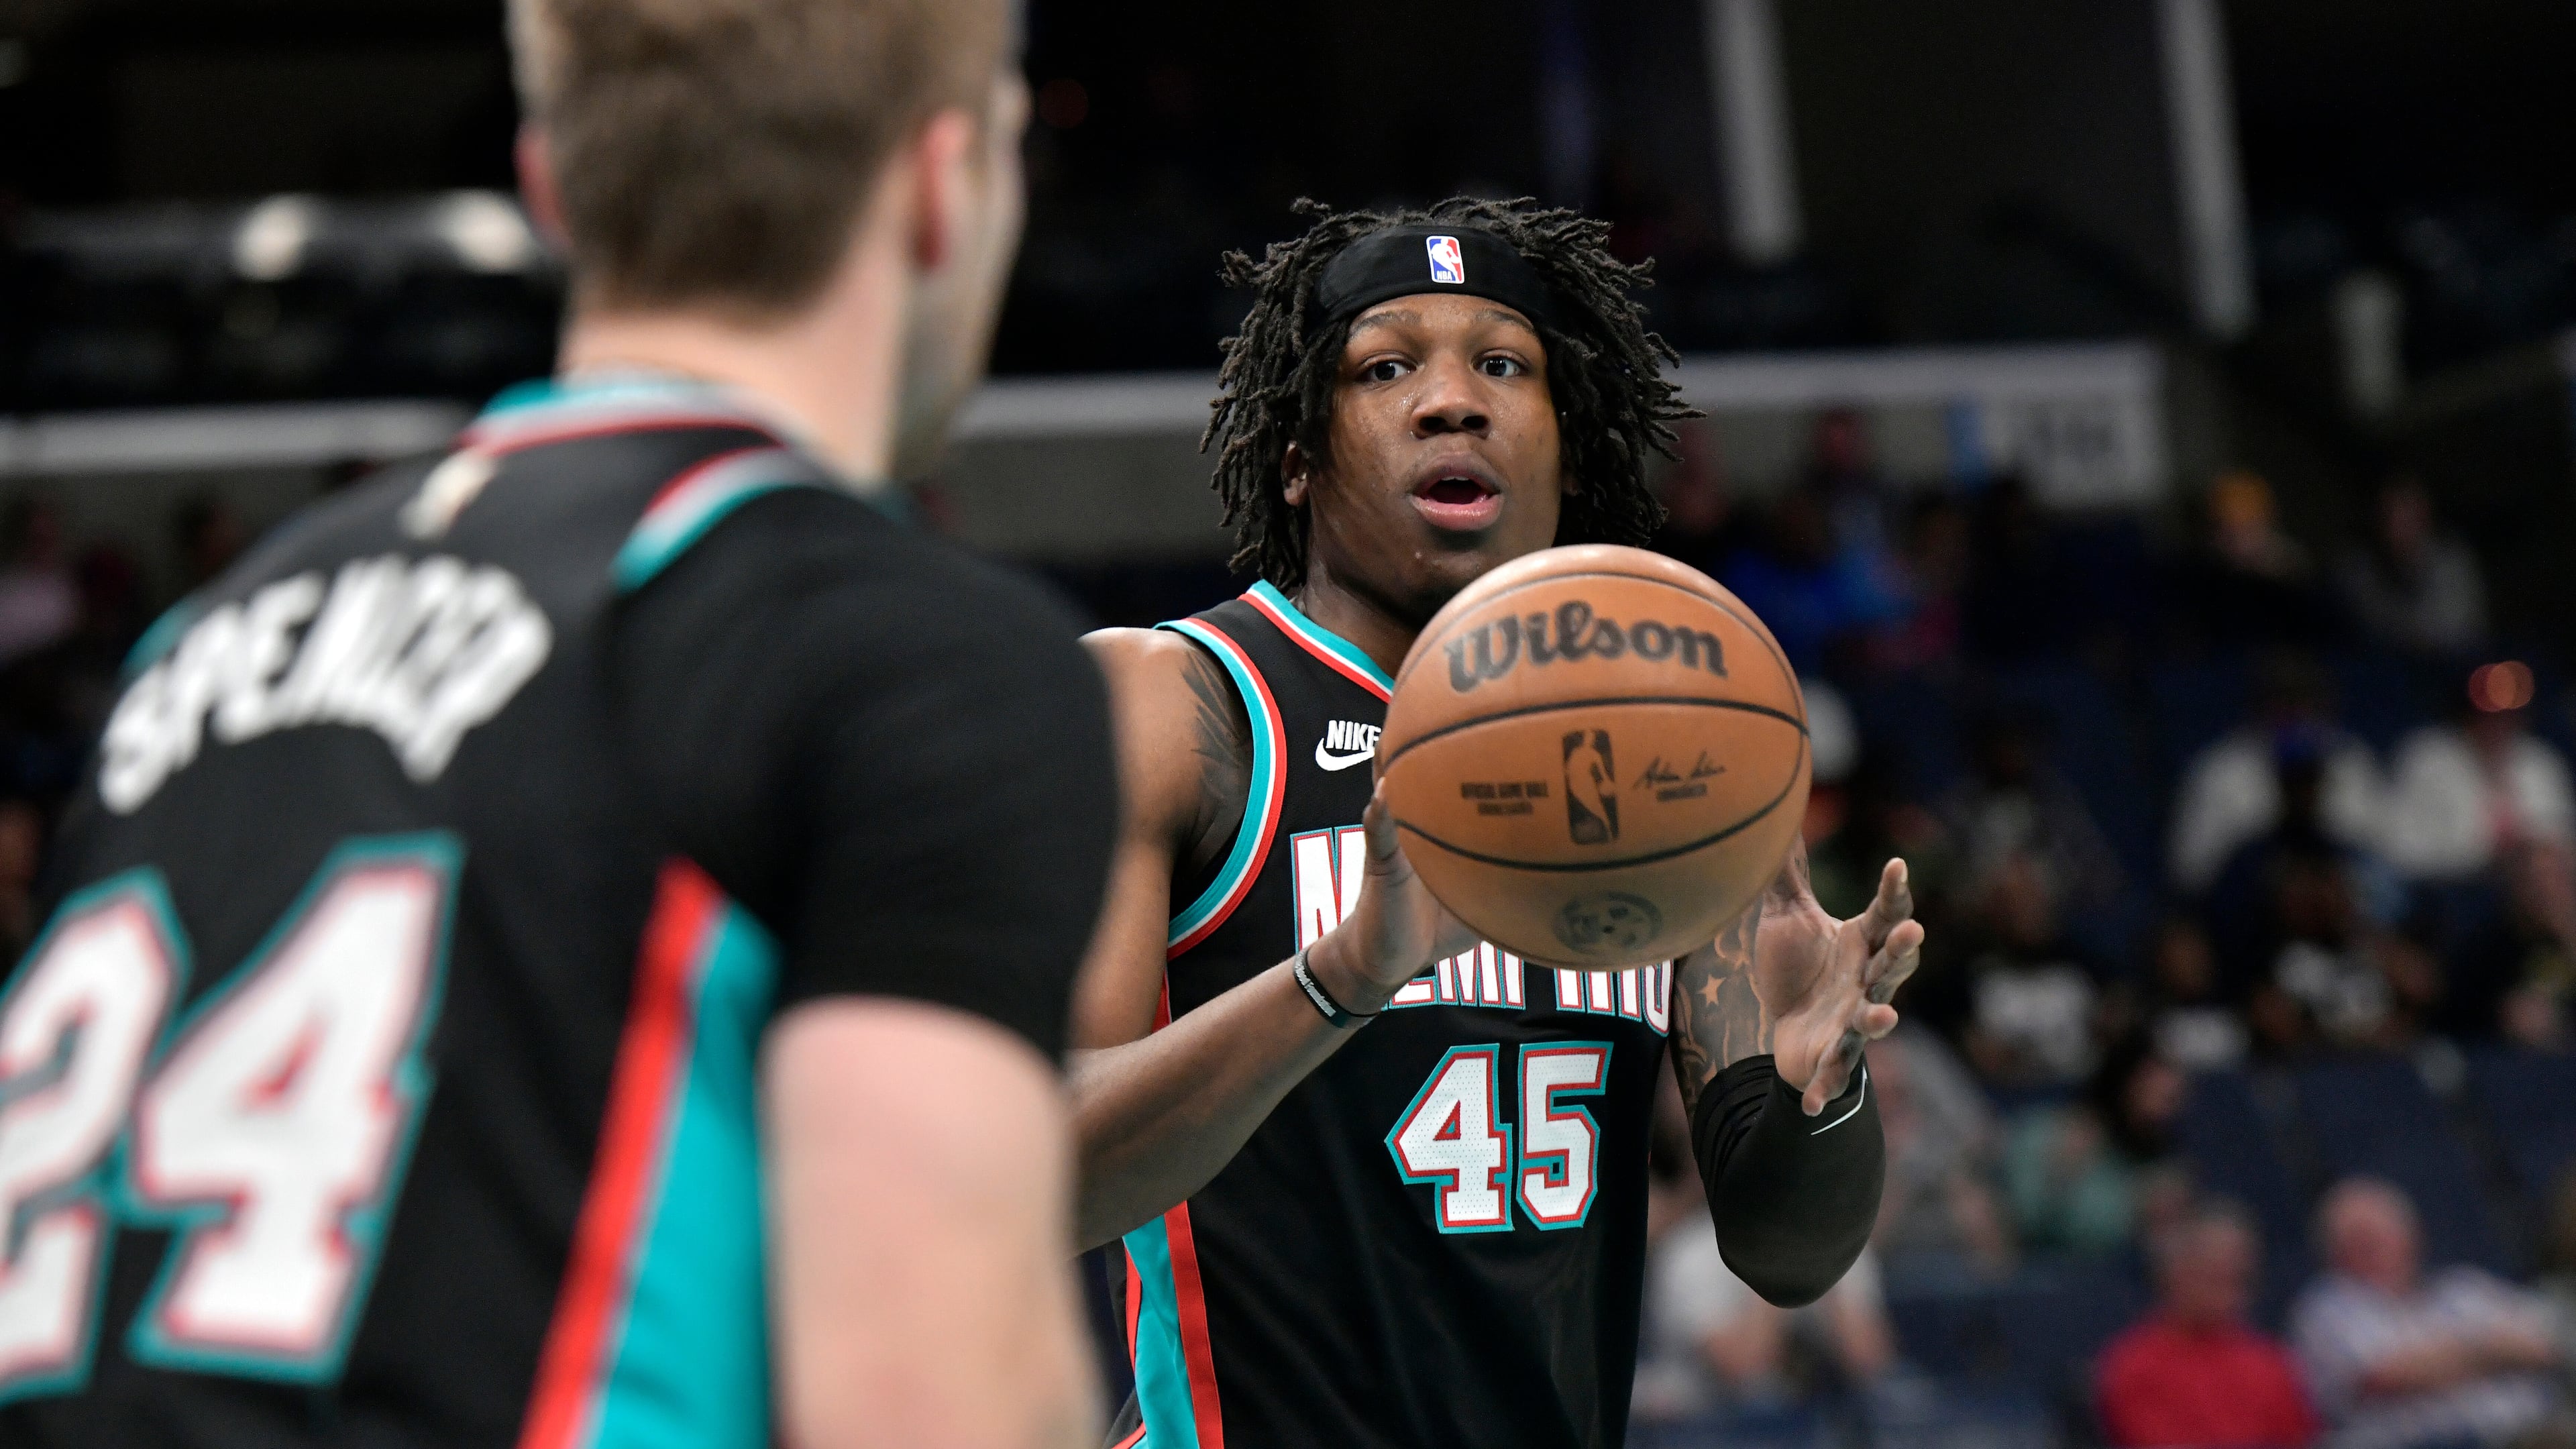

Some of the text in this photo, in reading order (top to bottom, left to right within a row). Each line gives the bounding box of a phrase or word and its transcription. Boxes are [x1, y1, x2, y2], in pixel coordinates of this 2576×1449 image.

[1436, 270, 1453, 280] NBA
[1444, 601, 1728, 692] Wilson
[1326, 720, 1382, 751] NIKE
[0, 829, 466, 1402] 24
[1384, 1041, 1614, 1234] 45
